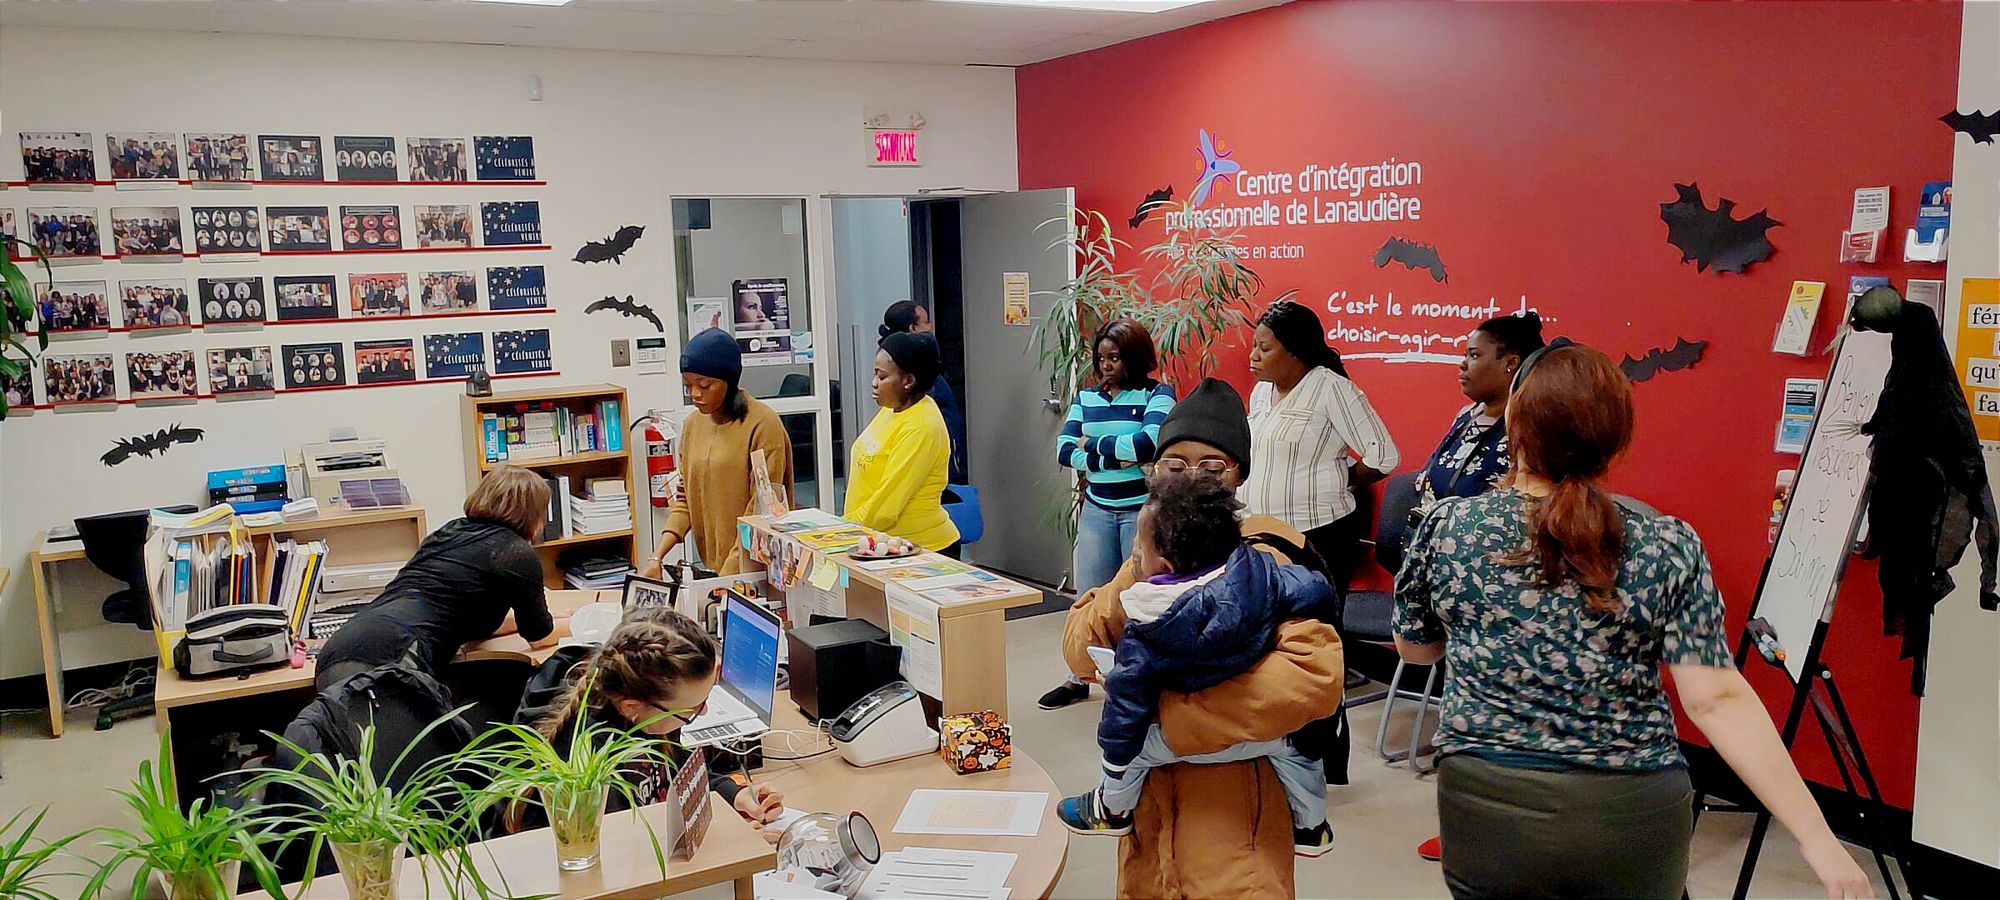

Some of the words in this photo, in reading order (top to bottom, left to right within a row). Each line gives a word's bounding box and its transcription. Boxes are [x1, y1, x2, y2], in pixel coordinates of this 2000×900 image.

[1236, 170, 1292, 197] Centre
[1298, 157, 1421, 197] d'intégration
[1286, 198, 1308, 224] de
[1313, 192, 1421, 224] Lanaudière
[1252, 245, 1266, 259] en
[1270, 241, 1304, 259] action
[1327, 291, 1379, 315] C'est
[1386, 292, 1402, 316] le
[1411, 297, 1501, 320] moment
